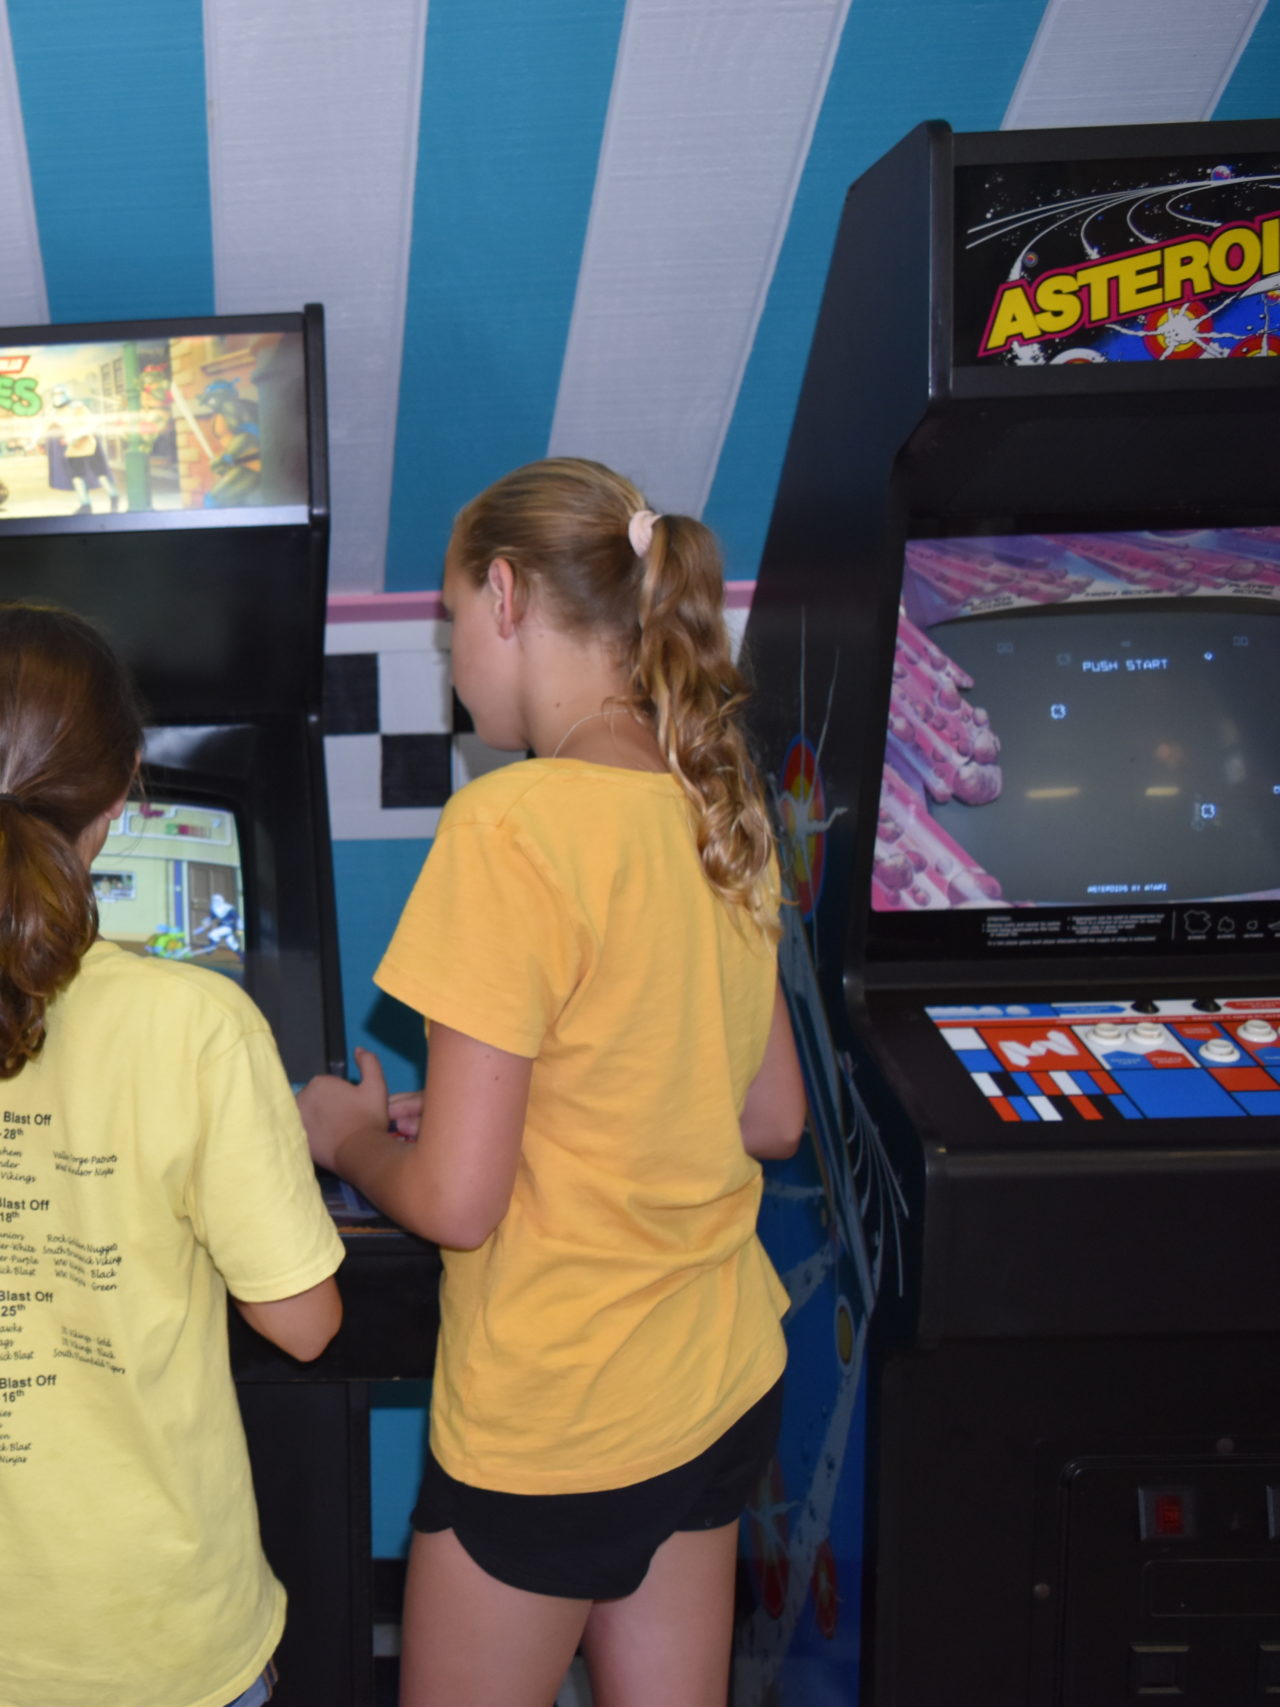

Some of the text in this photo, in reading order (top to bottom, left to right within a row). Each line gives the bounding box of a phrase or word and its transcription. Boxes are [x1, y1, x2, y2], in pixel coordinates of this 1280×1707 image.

[1082, 658, 1169, 673] PUSH START
[3, 1111, 31, 1125] Blast
[34, 1113, 52, 1126] Off
[1, 1171, 36, 1184] Vikings
[30, 1200, 50, 1211] Off
[13, 1266, 36, 1276] Blast
[35, 1291, 54, 1303] Off
[13, 1350, 35, 1361] Blast
[0, 1377, 32, 1389] Blast
[36, 1374, 57, 1387] Off
[10, 1442, 32, 1452] Blast
